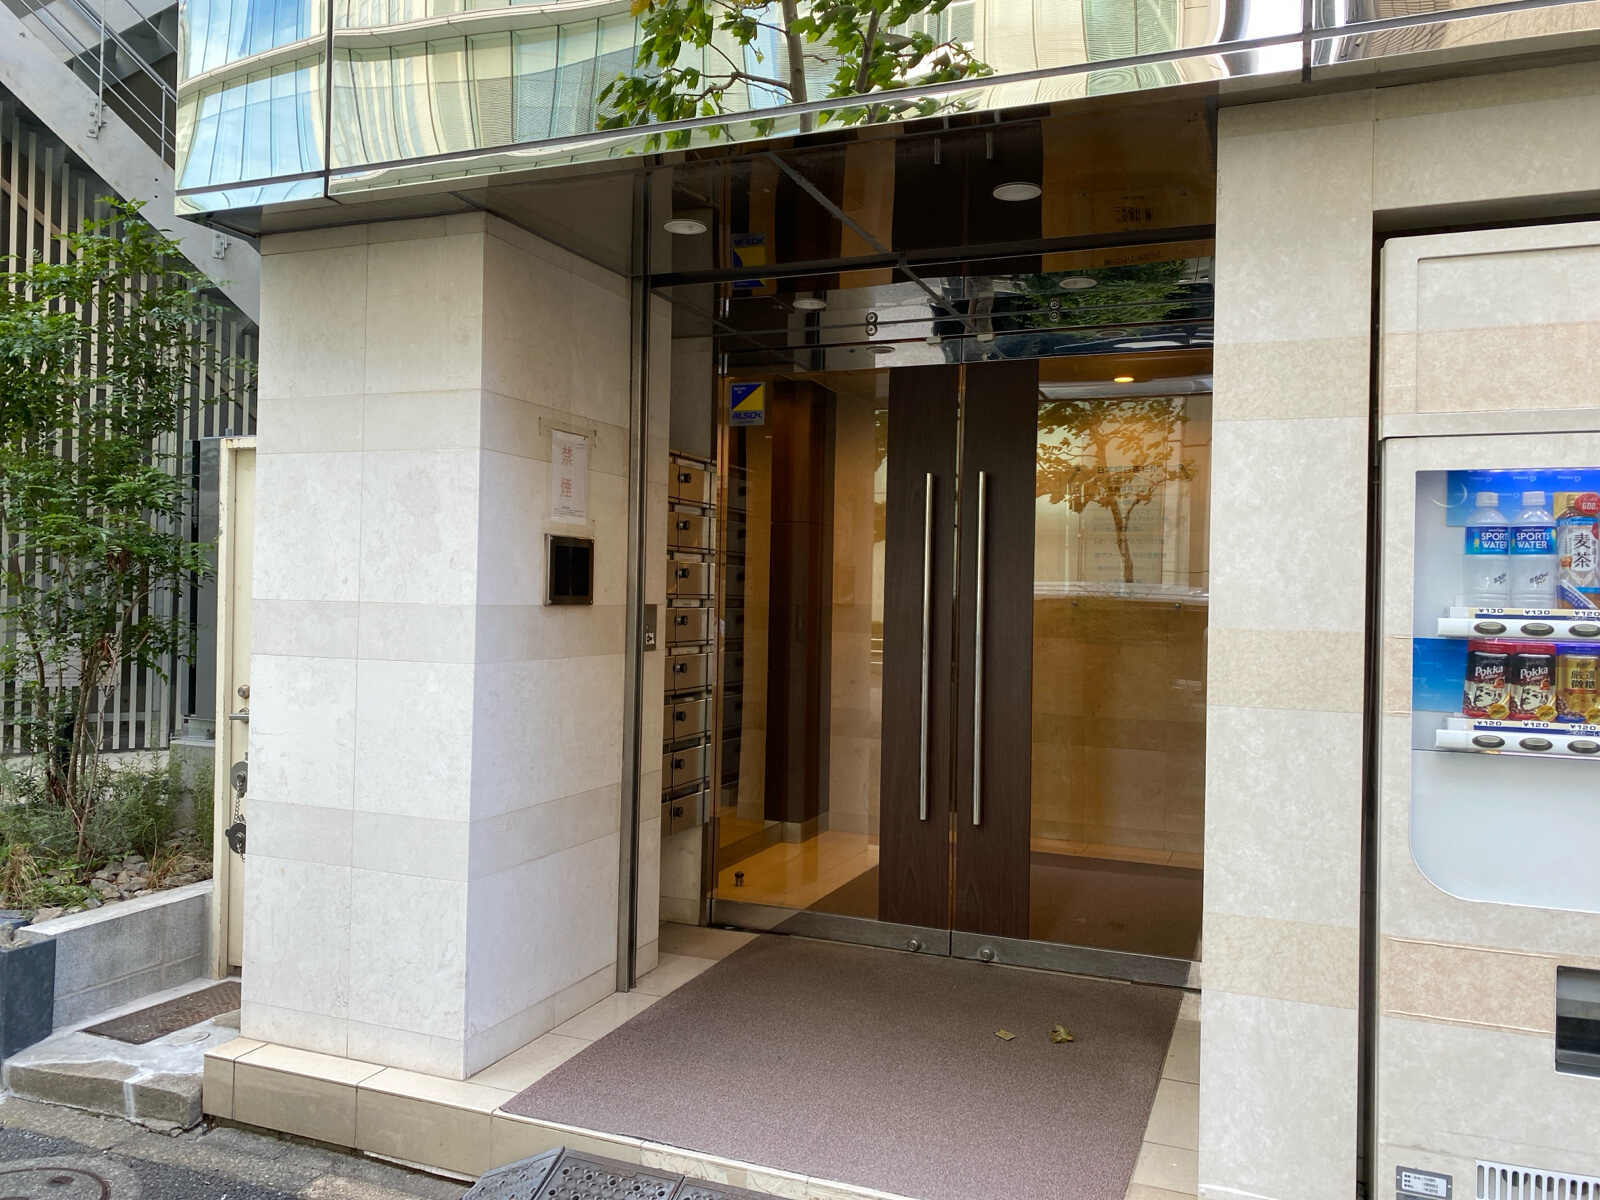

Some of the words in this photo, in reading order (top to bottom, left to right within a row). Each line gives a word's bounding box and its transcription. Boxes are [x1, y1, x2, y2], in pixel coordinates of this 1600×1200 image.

[1516, 532, 1550, 541] SPORTS
[1516, 540, 1548, 549] WATER
[1573, 533, 1592, 569] 麦茶
[1474, 665, 1504, 677] Pokka
[1520, 666, 1549, 679] Pokka
[1570, 723, 1597, 731] ¥120
